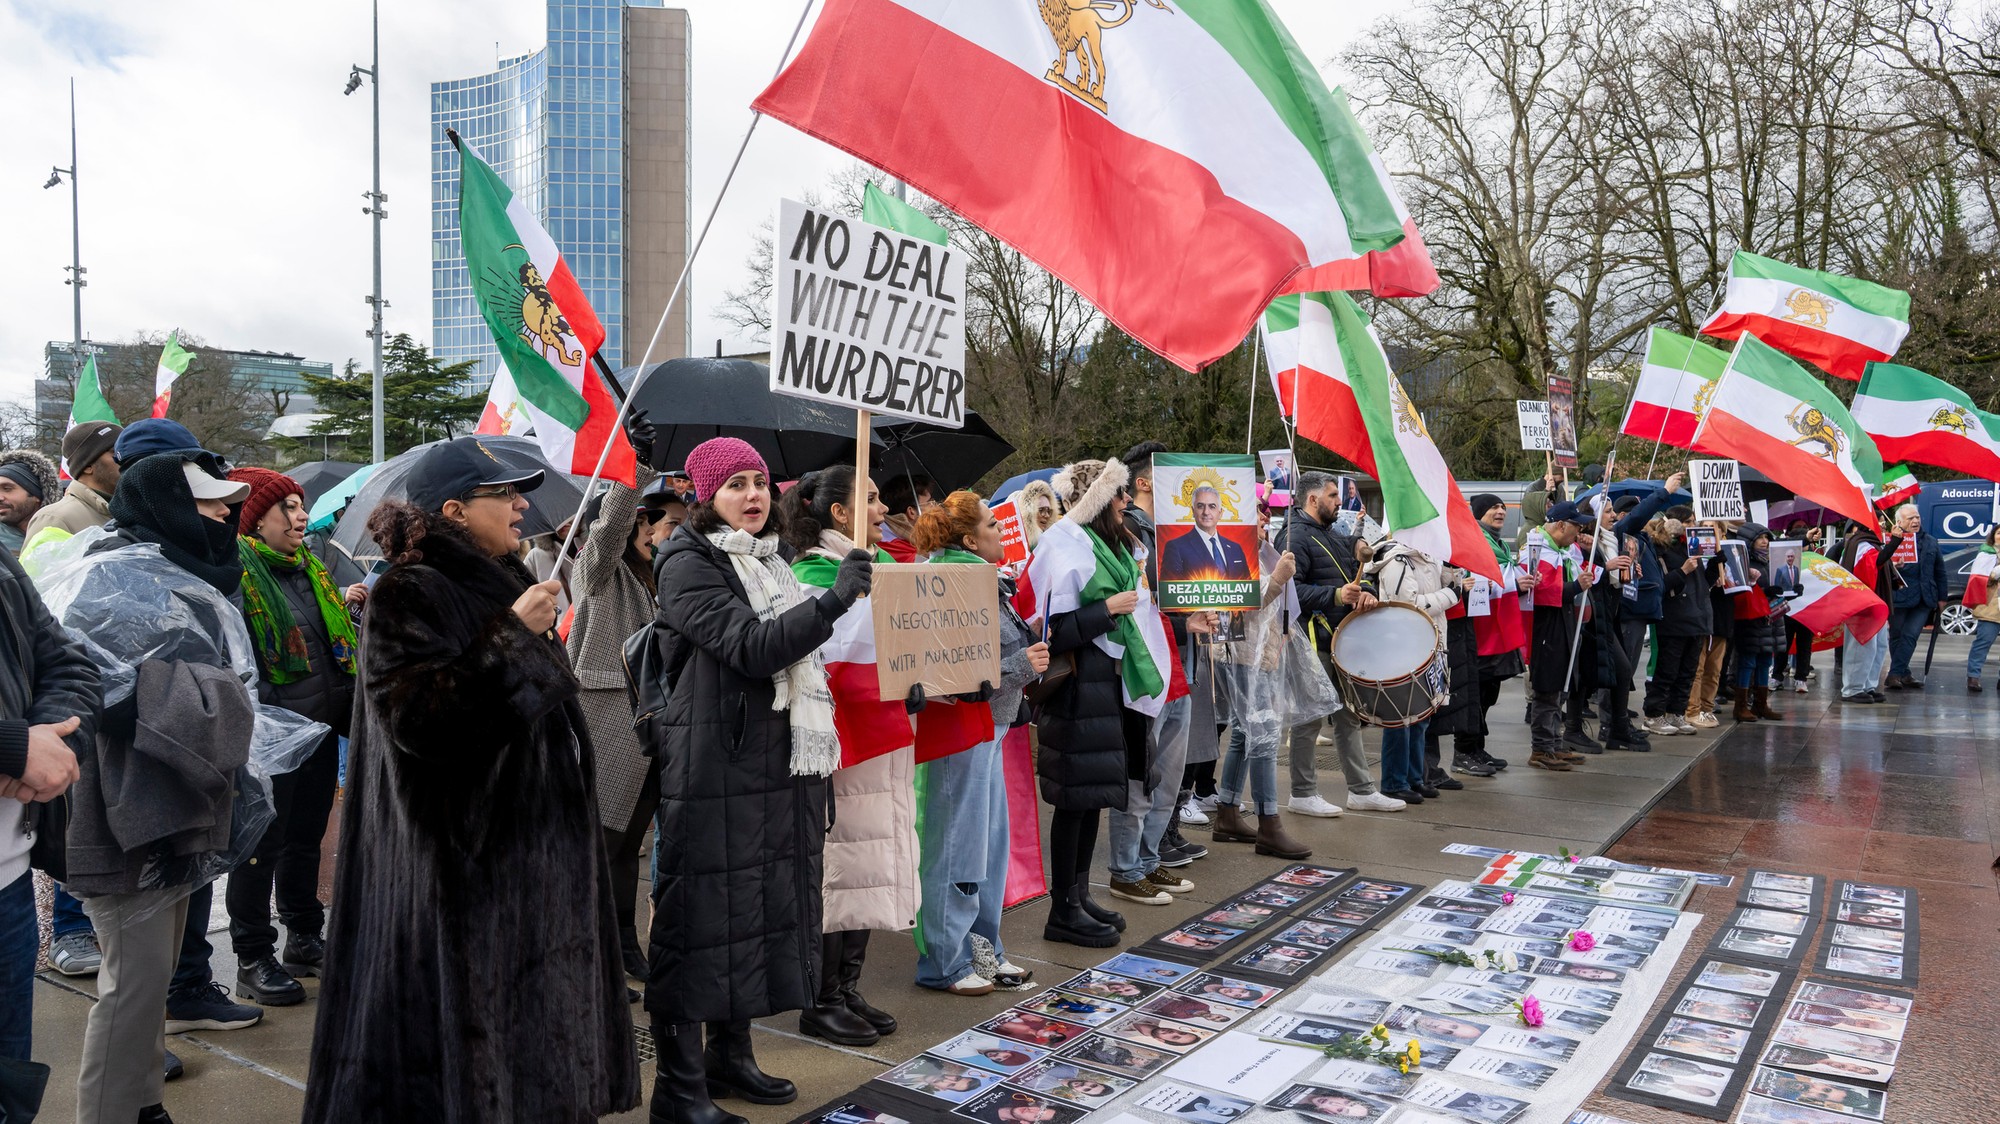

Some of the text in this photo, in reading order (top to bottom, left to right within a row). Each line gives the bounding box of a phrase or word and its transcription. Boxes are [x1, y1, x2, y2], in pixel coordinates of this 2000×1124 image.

[789, 209, 957, 304] NO DEAL
[790, 268, 957, 359] WITH THE
[777, 330, 965, 422] MURDERER
[1519, 402, 1544, 412] ISLAMIC
[1542, 414, 1549, 425] IS
[1523, 426, 1548, 437] TERRO
[1535, 439, 1552, 449] STA
[1703, 463, 1734, 479] DOWN
[1941, 488, 1994, 498] Adoucisse
[1701, 501, 1741, 517] MULLAHS
[1943, 511, 1993, 538] Cu
[915, 574, 946, 598] NO
[1168, 584, 1253, 594] REZA PAHLAVI
[1177, 595, 1243, 604] OUR LEADER
[889, 608, 989, 630] NEGOTIATIONS
[888, 642, 992, 673] WITH MURDERERS
[1228, 1071, 1247, 1084] WORLD
